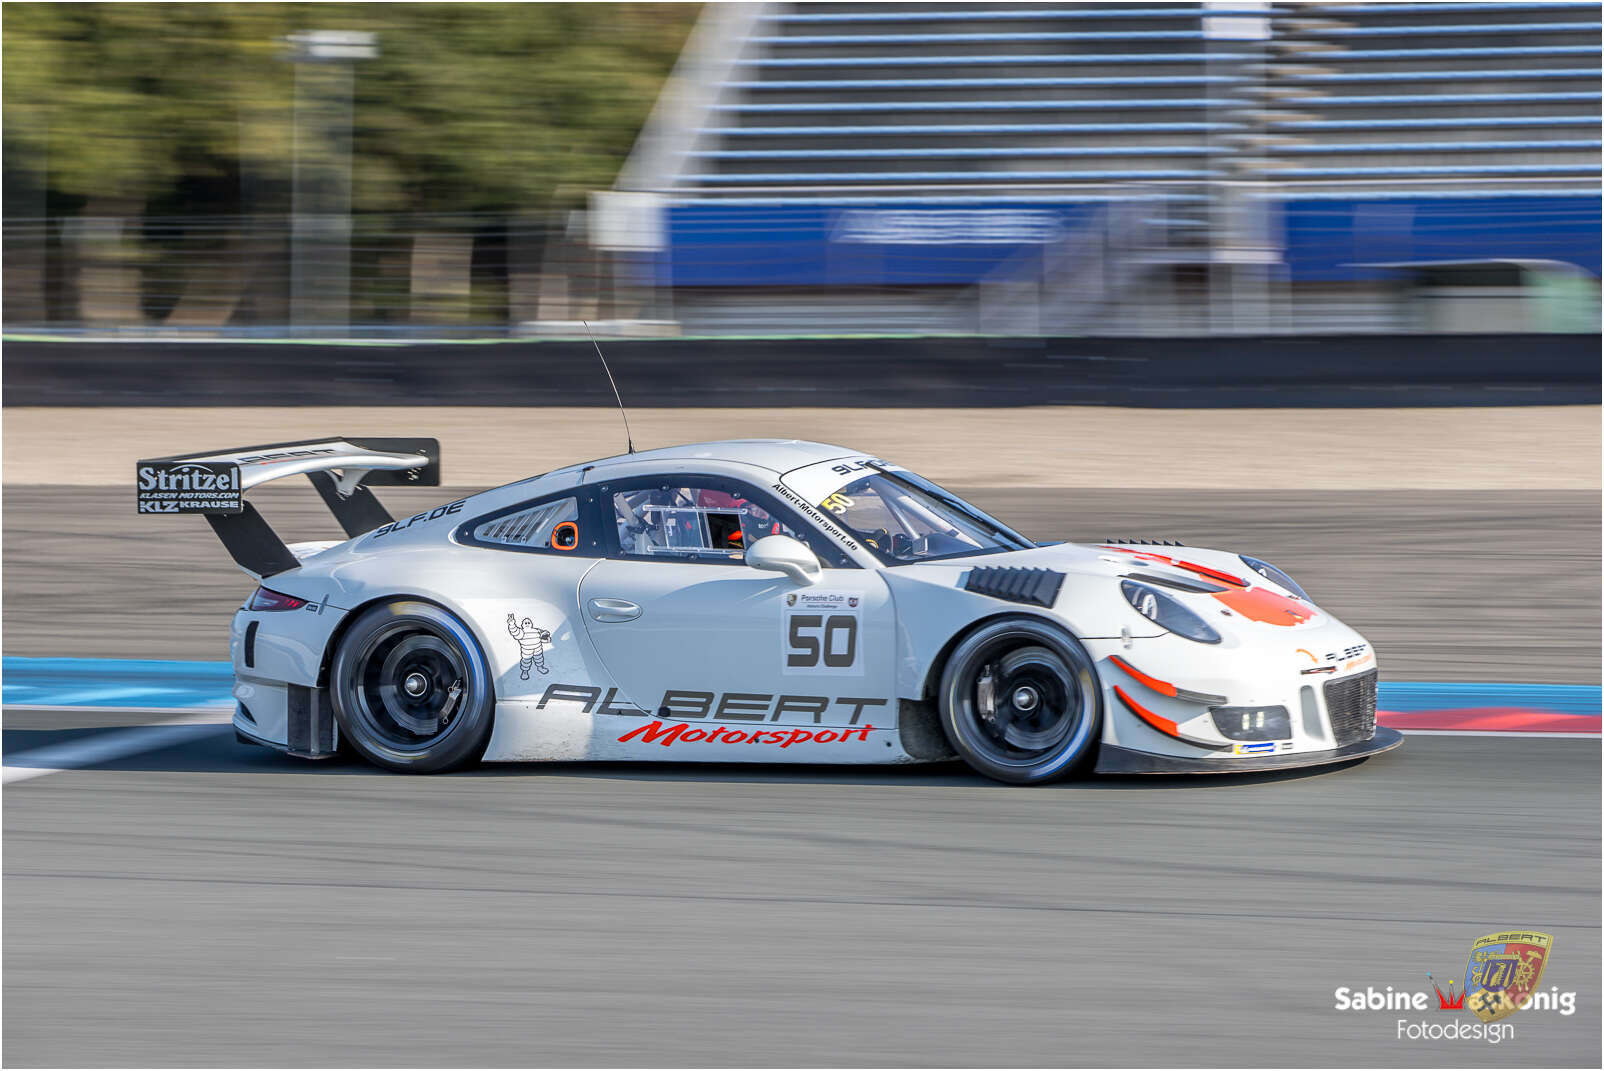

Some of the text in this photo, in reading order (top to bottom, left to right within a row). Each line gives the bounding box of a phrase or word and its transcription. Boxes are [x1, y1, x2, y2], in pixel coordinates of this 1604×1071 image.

[139, 464, 239, 490] Stritzel
[140, 501, 179, 512] KLZ
[374, 500, 466, 538] 9LF.DE
[772, 483, 858, 551] Albert-Motorsport.de
[820, 493, 855, 514] 50
[787, 615, 857, 667] 50
[536, 683, 888, 725] ALBERT
[617, 720, 876, 749] Motorsport
